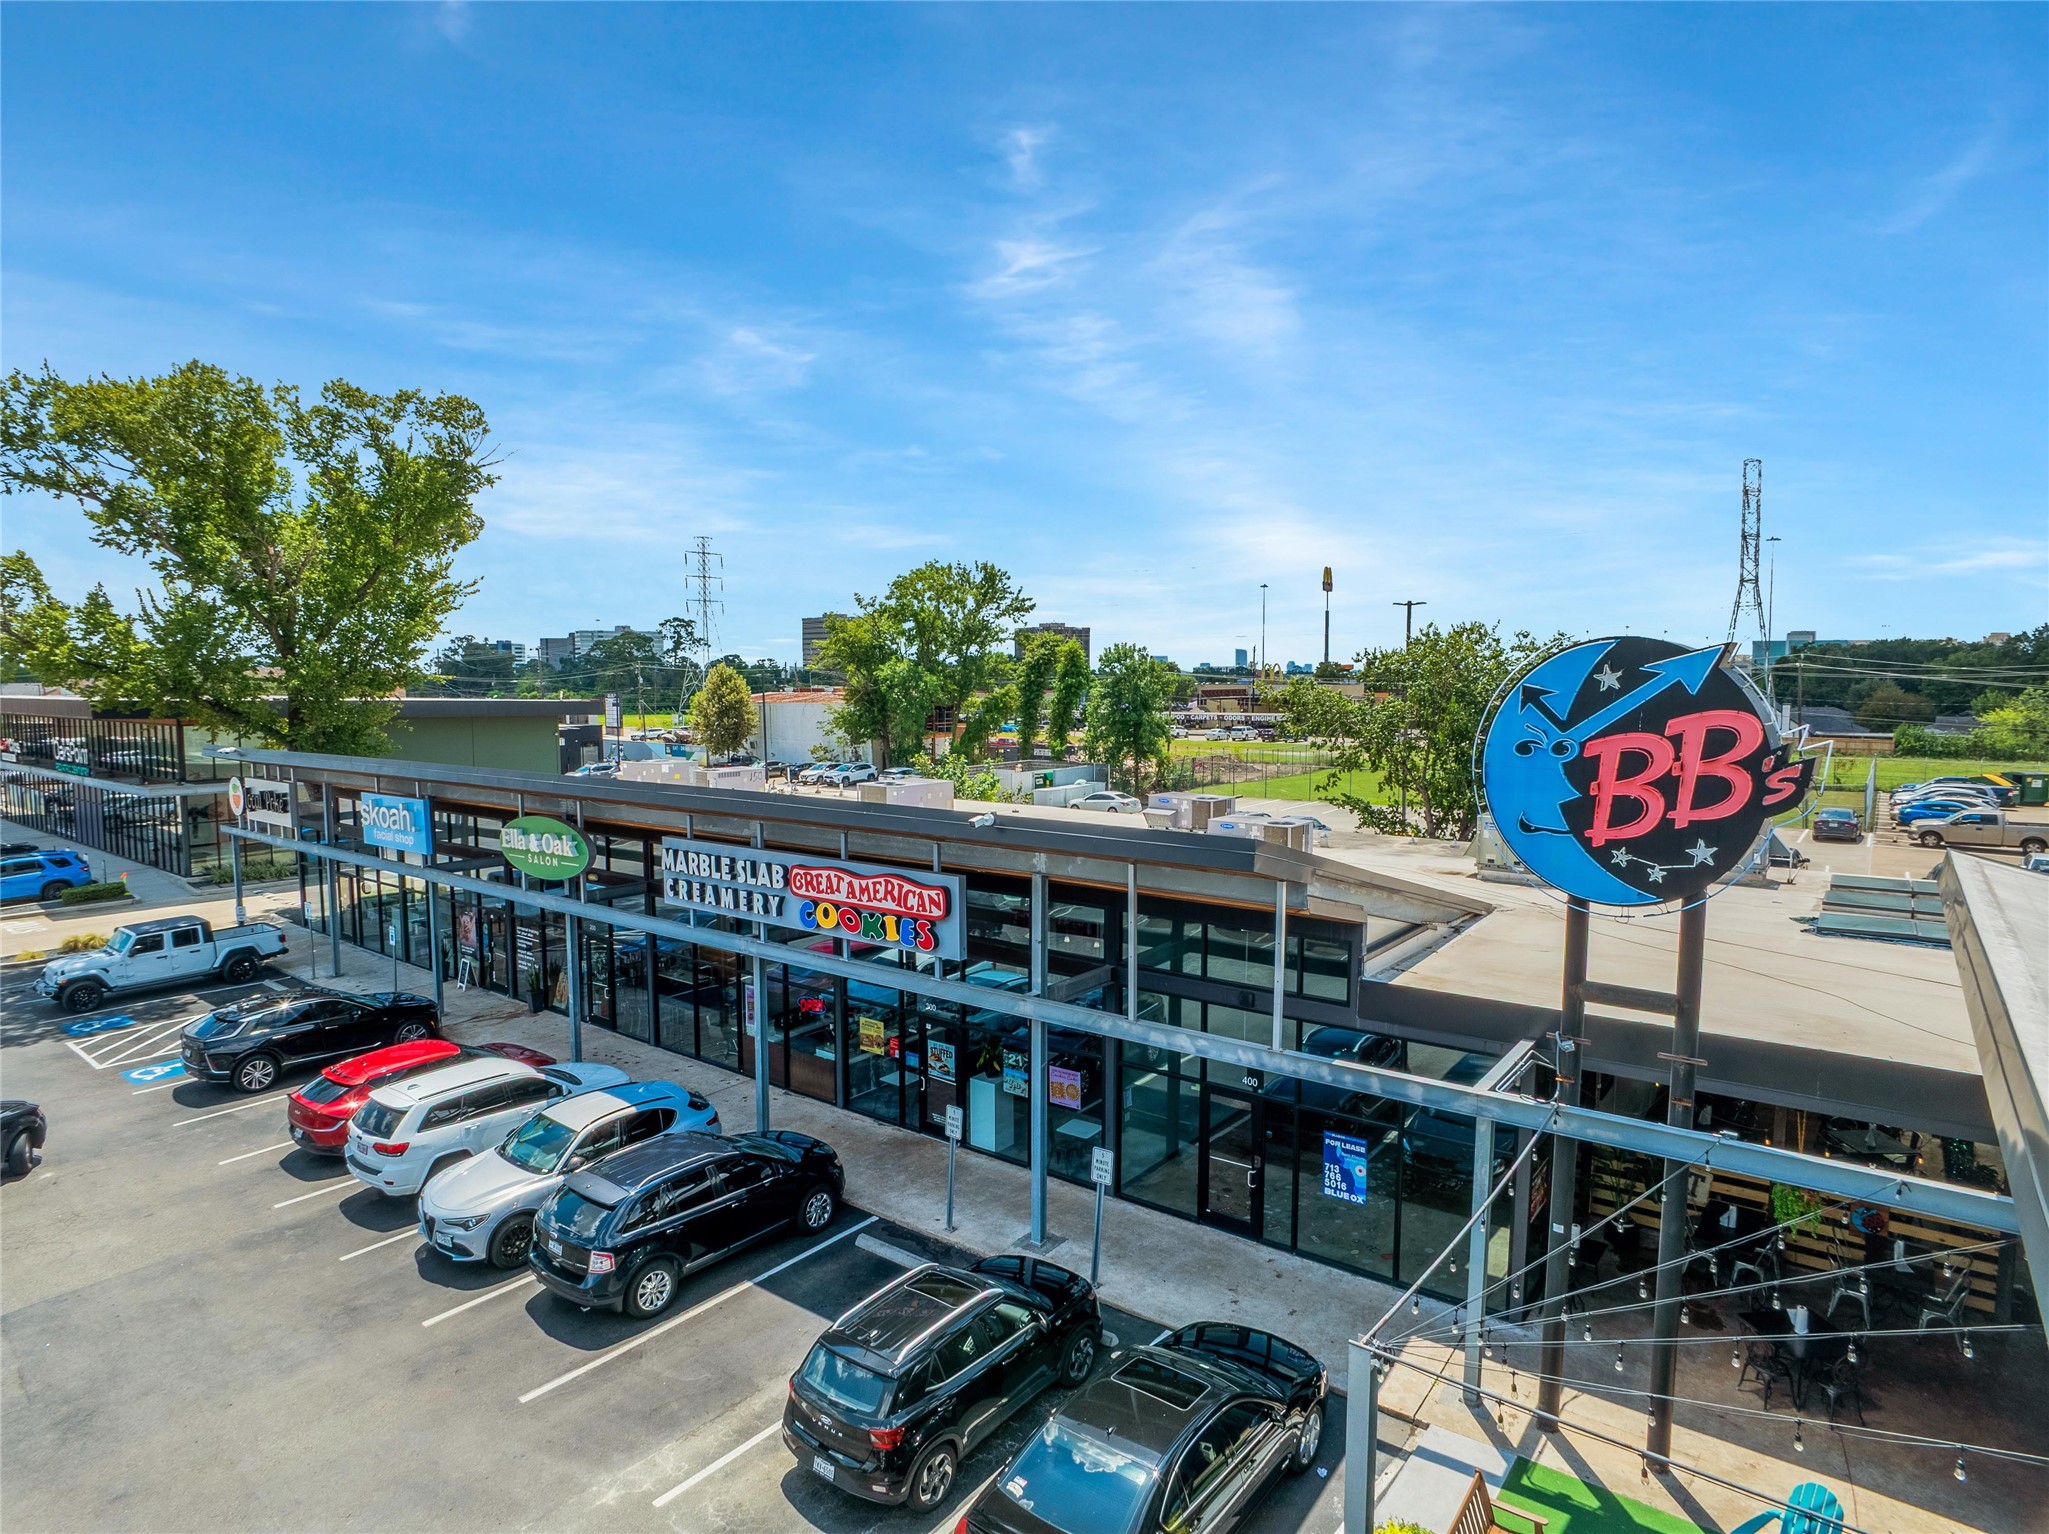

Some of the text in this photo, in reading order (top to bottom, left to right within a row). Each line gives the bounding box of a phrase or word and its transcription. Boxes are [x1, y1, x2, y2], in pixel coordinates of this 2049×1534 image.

[1582, 709, 1804, 848] BB's
[374, 828, 414, 847] facial shop
[501, 827, 579, 857] Ella & Oak
[527, 853, 558, 867] SALON
[661, 848, 785, 889] MARBLE SLAB
[666, 878, 780, 917] CREAMERY
[792, 871, 942, 914] GREAT AMERICAN
[800, 900, 934, 951] COOKIES
[800, 998, 824, 1012] OPEN
[930, 1046, 953, 1059] STUFFED
[1242, 1076, 1258, 1087] 400
[1325, 1138, 1340, 1147] FOR
[1341, 1142, 1366, 1153] LEASE
[1094, 1165, 1110, 1175] PARKING
[1095, 1159, 1110, 1167] MINUTE
[1324, 1162, 1340, 1173] 713
[1096, 1173, 1107, 1181] ONLY
[1324, 1170, 1341, 1181] 766
[1324, 1178, 1347, 1191] 5016
[1324, 1187, 1364, 1205] BLUE OX
[812, 1417, 843, 1437] VENUS
